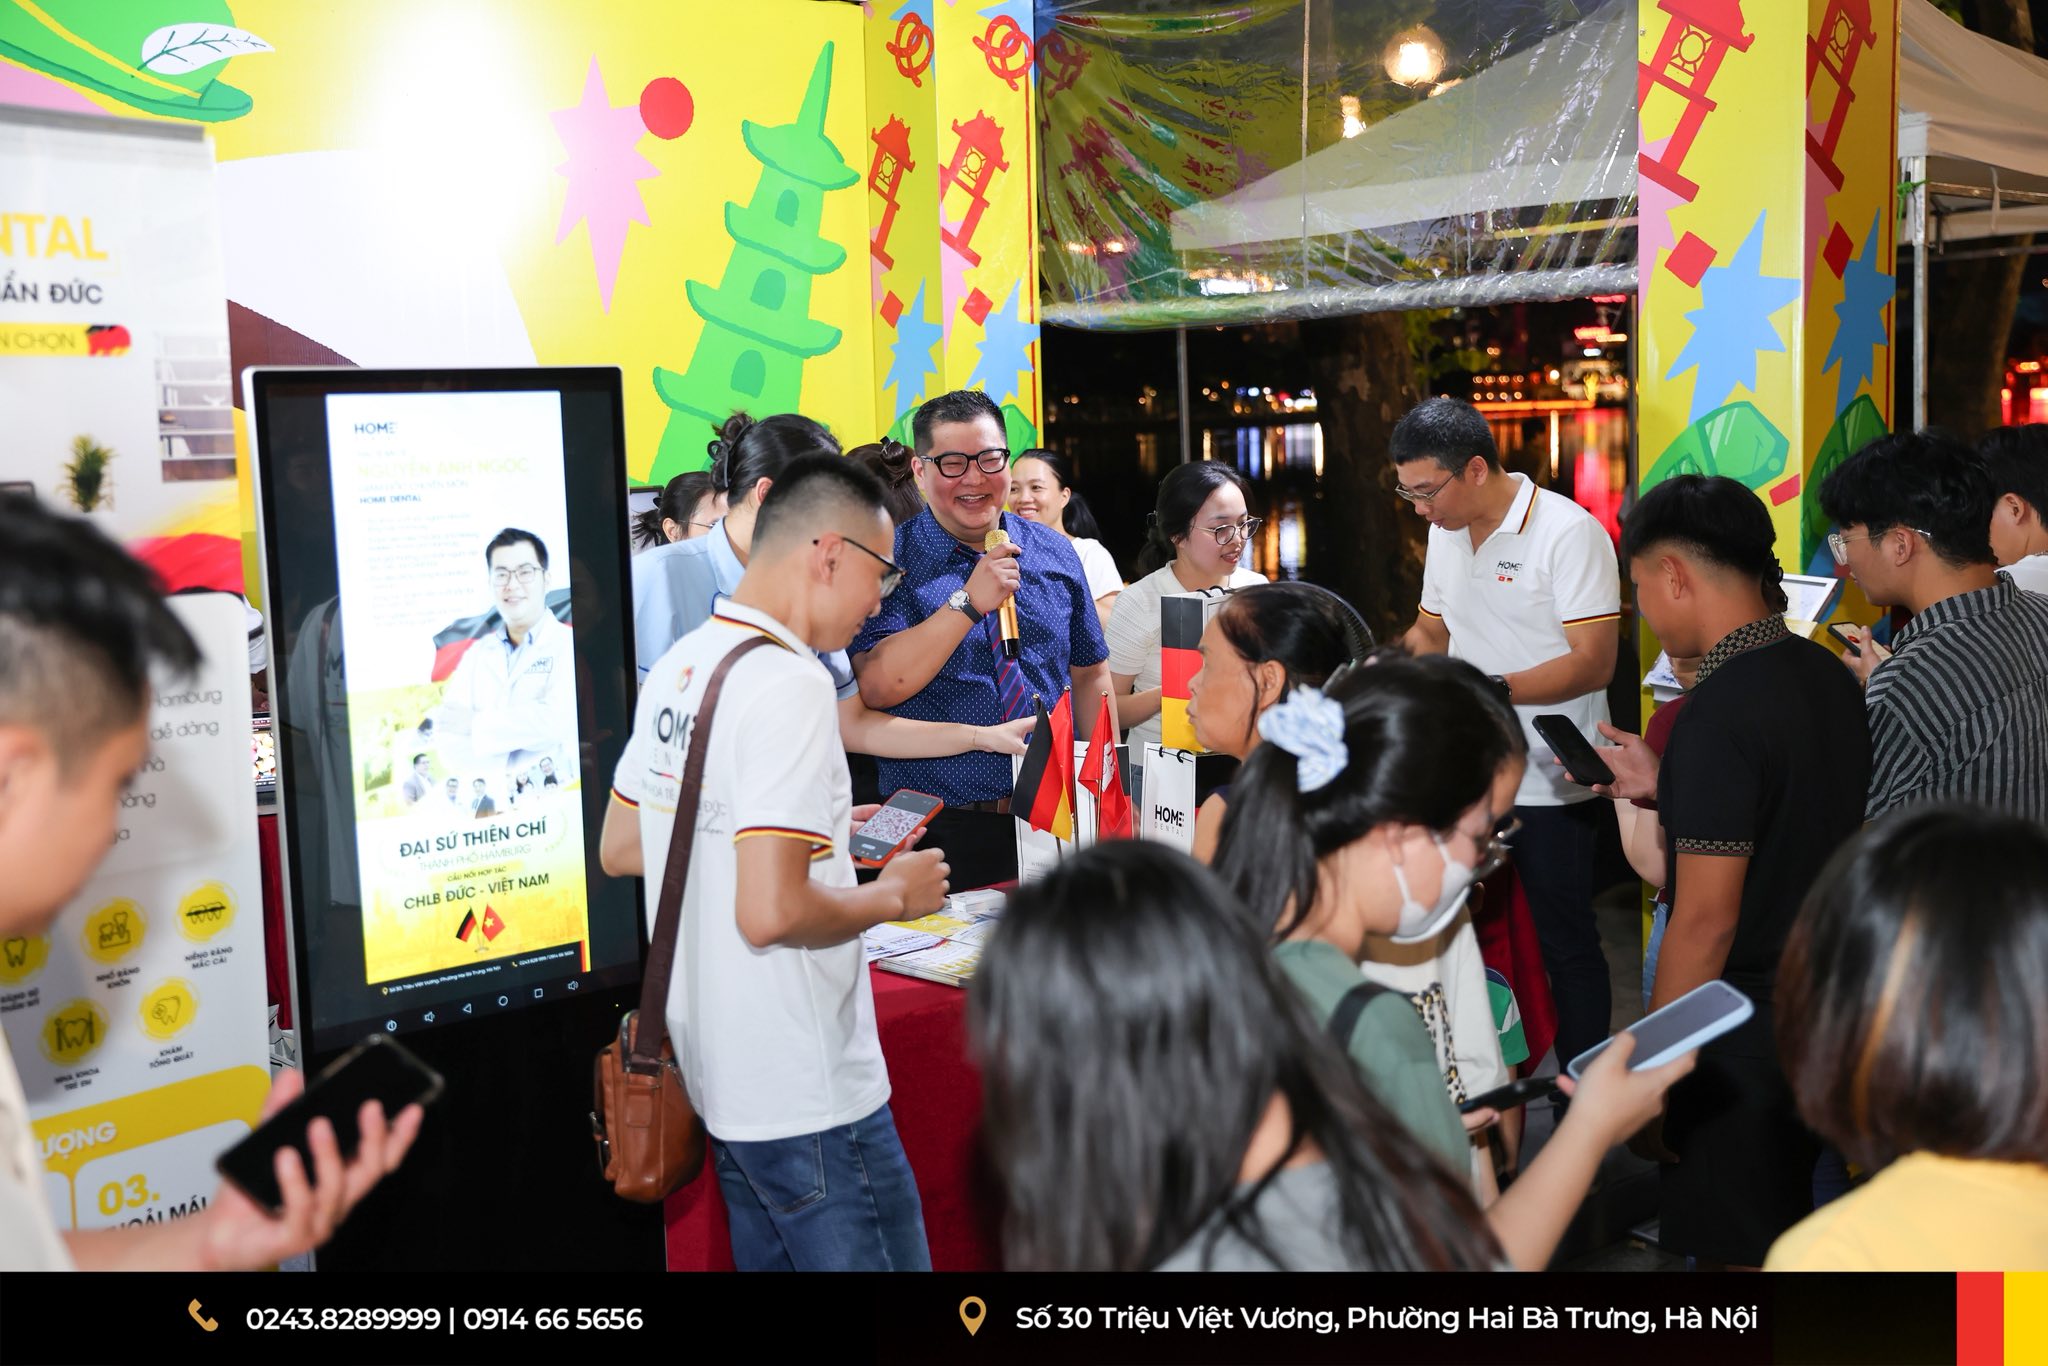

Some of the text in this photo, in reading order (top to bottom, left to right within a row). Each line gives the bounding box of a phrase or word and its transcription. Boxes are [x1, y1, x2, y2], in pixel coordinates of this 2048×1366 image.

[49, 278, 103, 305] ĐỨC
[354, 421, 397, 435] HOME
[359, 493, 422, 505] HOME DENTAL
[1496, 560, 1523, 571] HOME
[176, 721, 220, 737] dàng
[1155, 804, 1185, 828] HOME
[400, 815, 548, 860] ĐẠI SỨ THIỆN CHÍ
[404, 892, 442, 910] CHLB
[445, 884, 477, 903] ĐỨC
[487, 877, 515, 896] VIỆT
[518, 872, 551, 889] NAM
[97, 1173, 160, 1217] 03.
